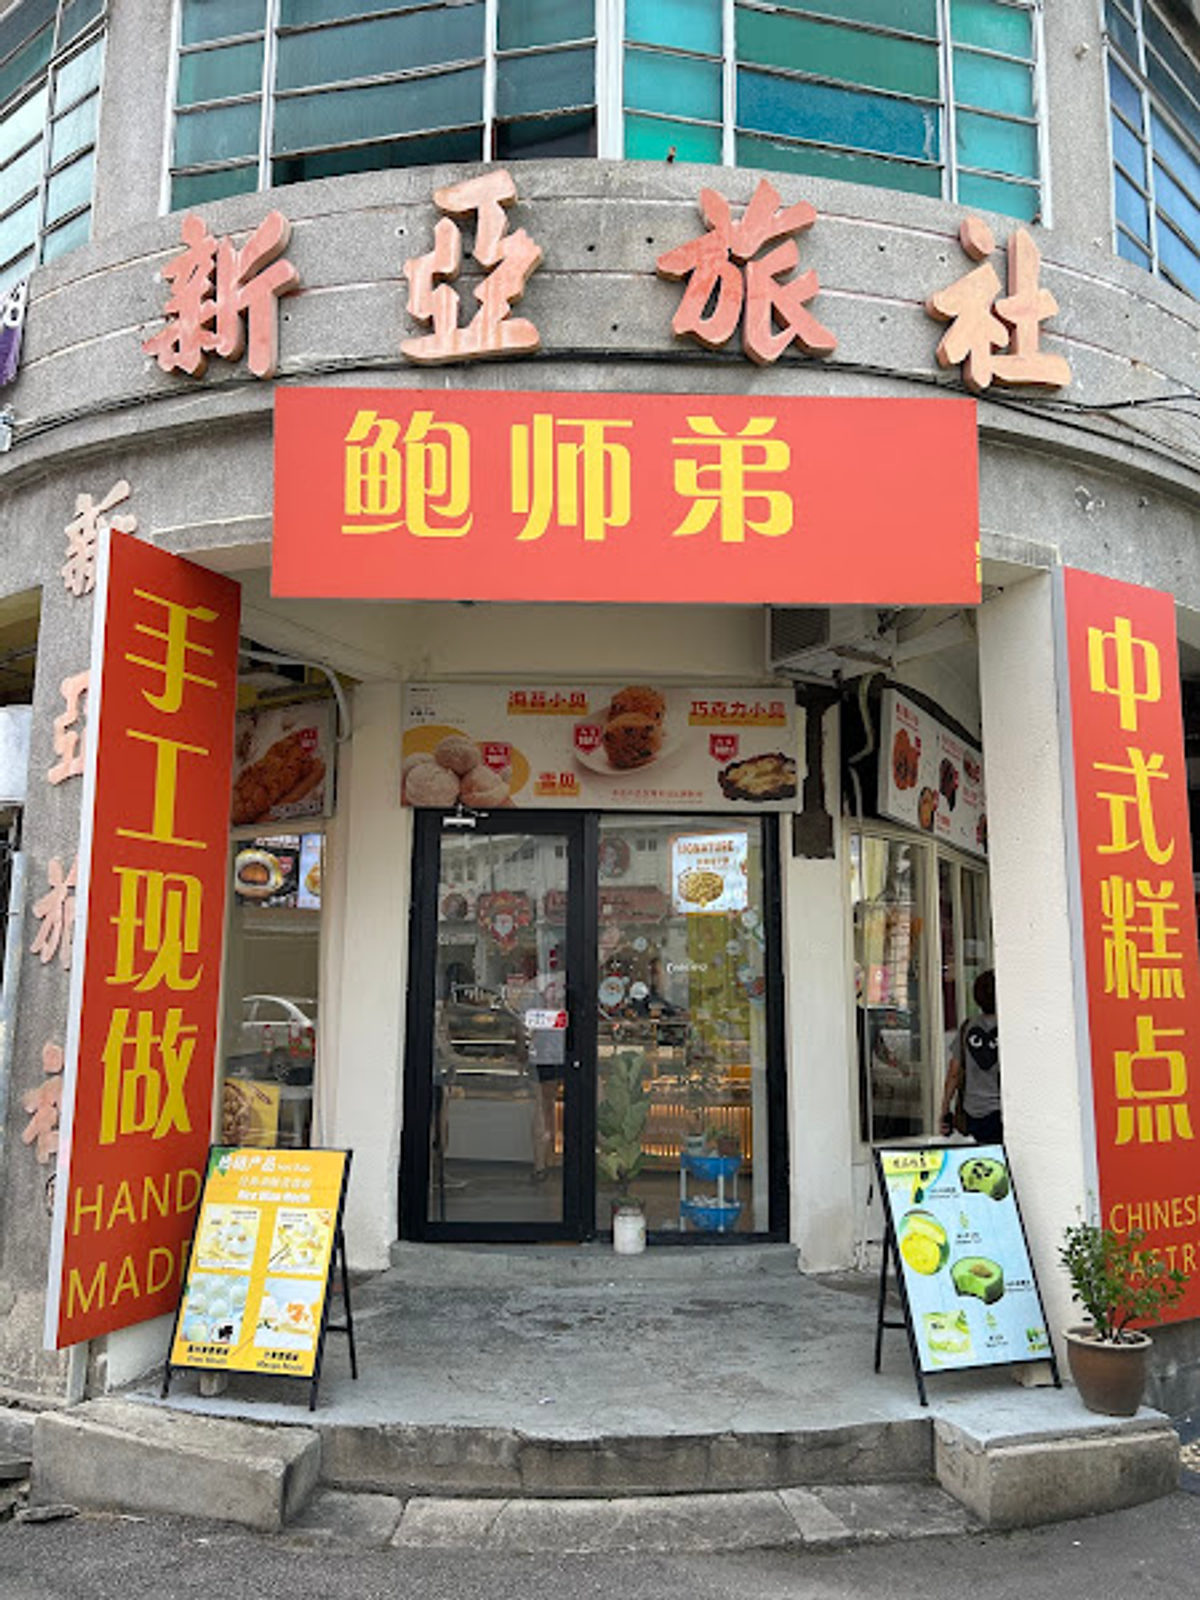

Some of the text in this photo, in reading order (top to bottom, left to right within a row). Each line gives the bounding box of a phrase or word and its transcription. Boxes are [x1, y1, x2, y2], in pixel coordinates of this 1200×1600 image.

[142, 169, 1071, 391] 新亞旅社
[341, 410, 793, 542] 鲍师弟
[100, 588, 219, 1145] 手工现做
[1088, 616, 1195, 1146] 中式糕点
[72, 1168, 201, 1236] HAND
[1109, 1194, 1200, 1234] CHINES
[66, 1239, 190, 1319] MAD
